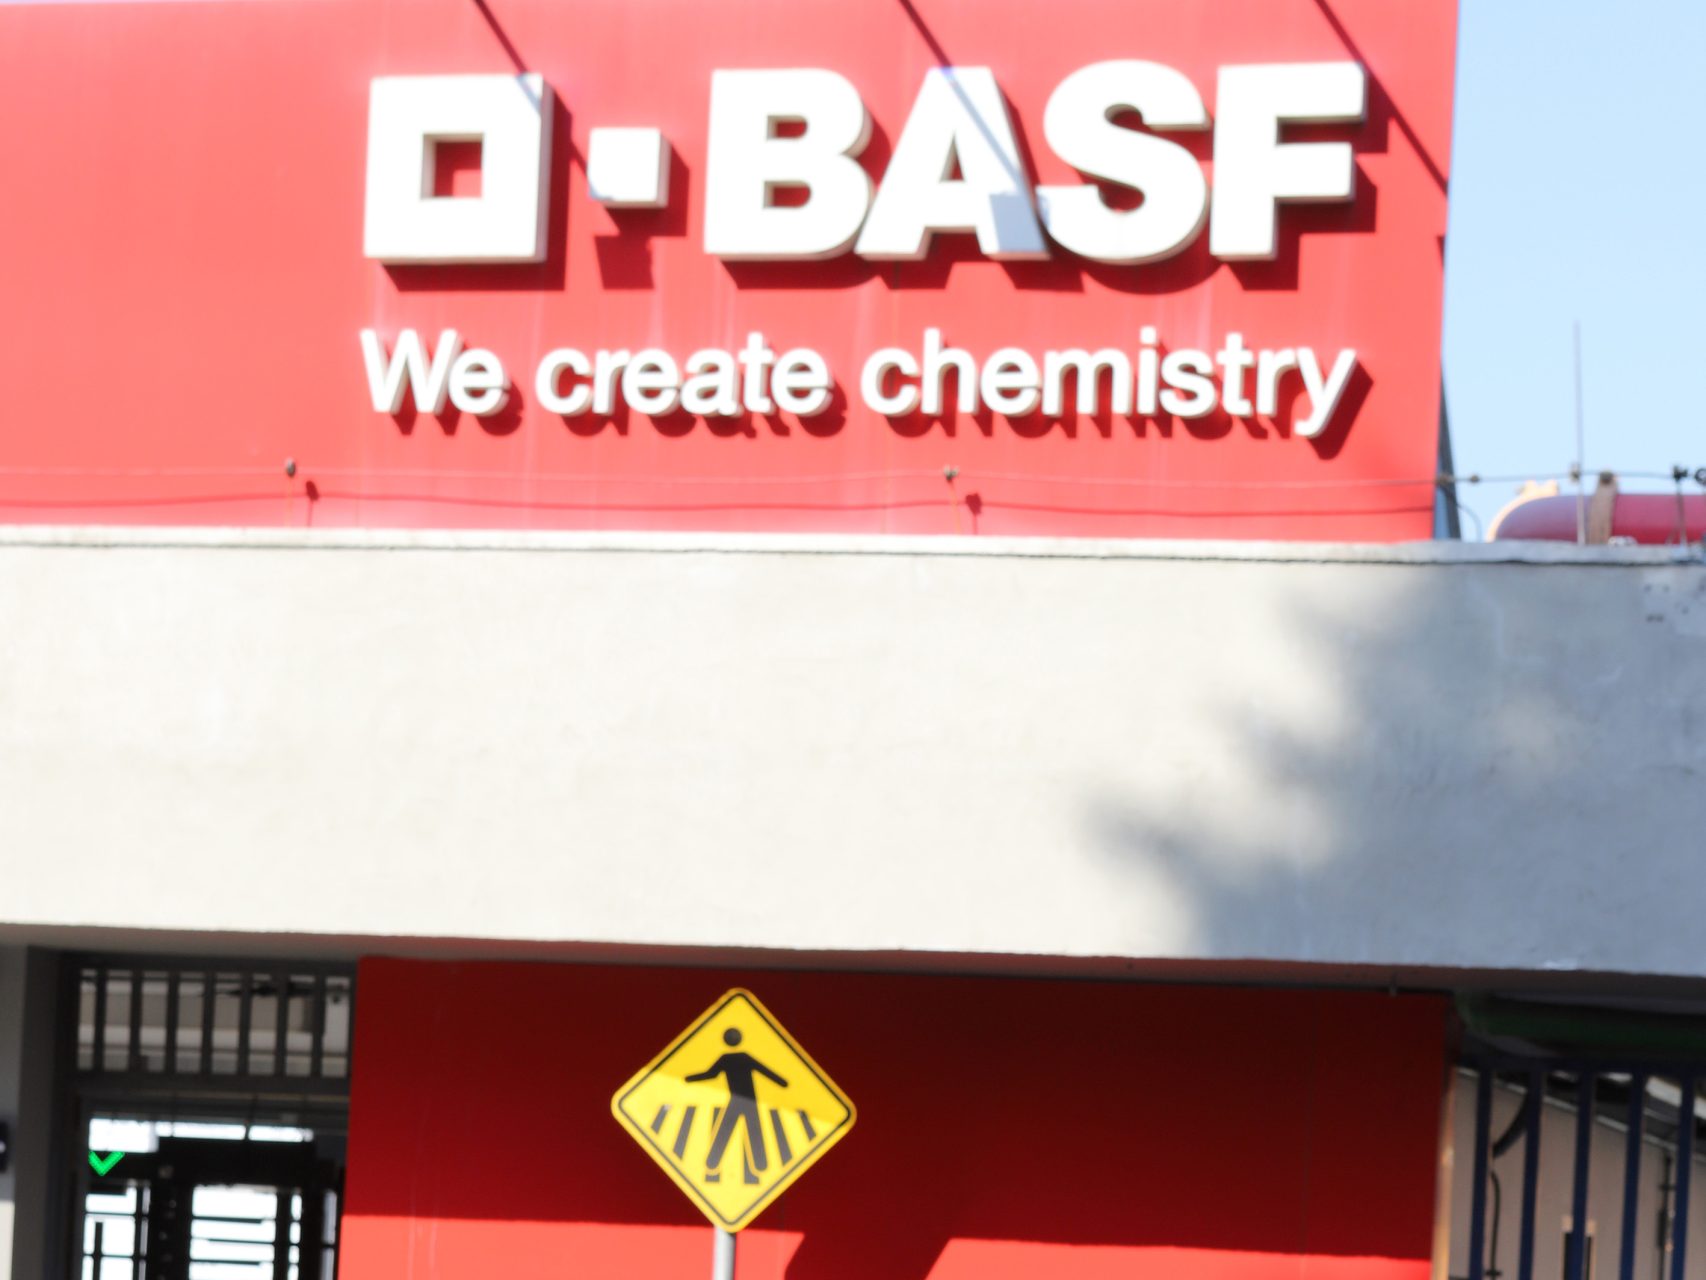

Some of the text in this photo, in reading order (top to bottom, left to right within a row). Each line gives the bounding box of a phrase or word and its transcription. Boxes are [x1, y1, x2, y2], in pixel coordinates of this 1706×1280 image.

[703, 60, 1367, 266] BASF
[359, 327, 1357, 440] We create chemistry
